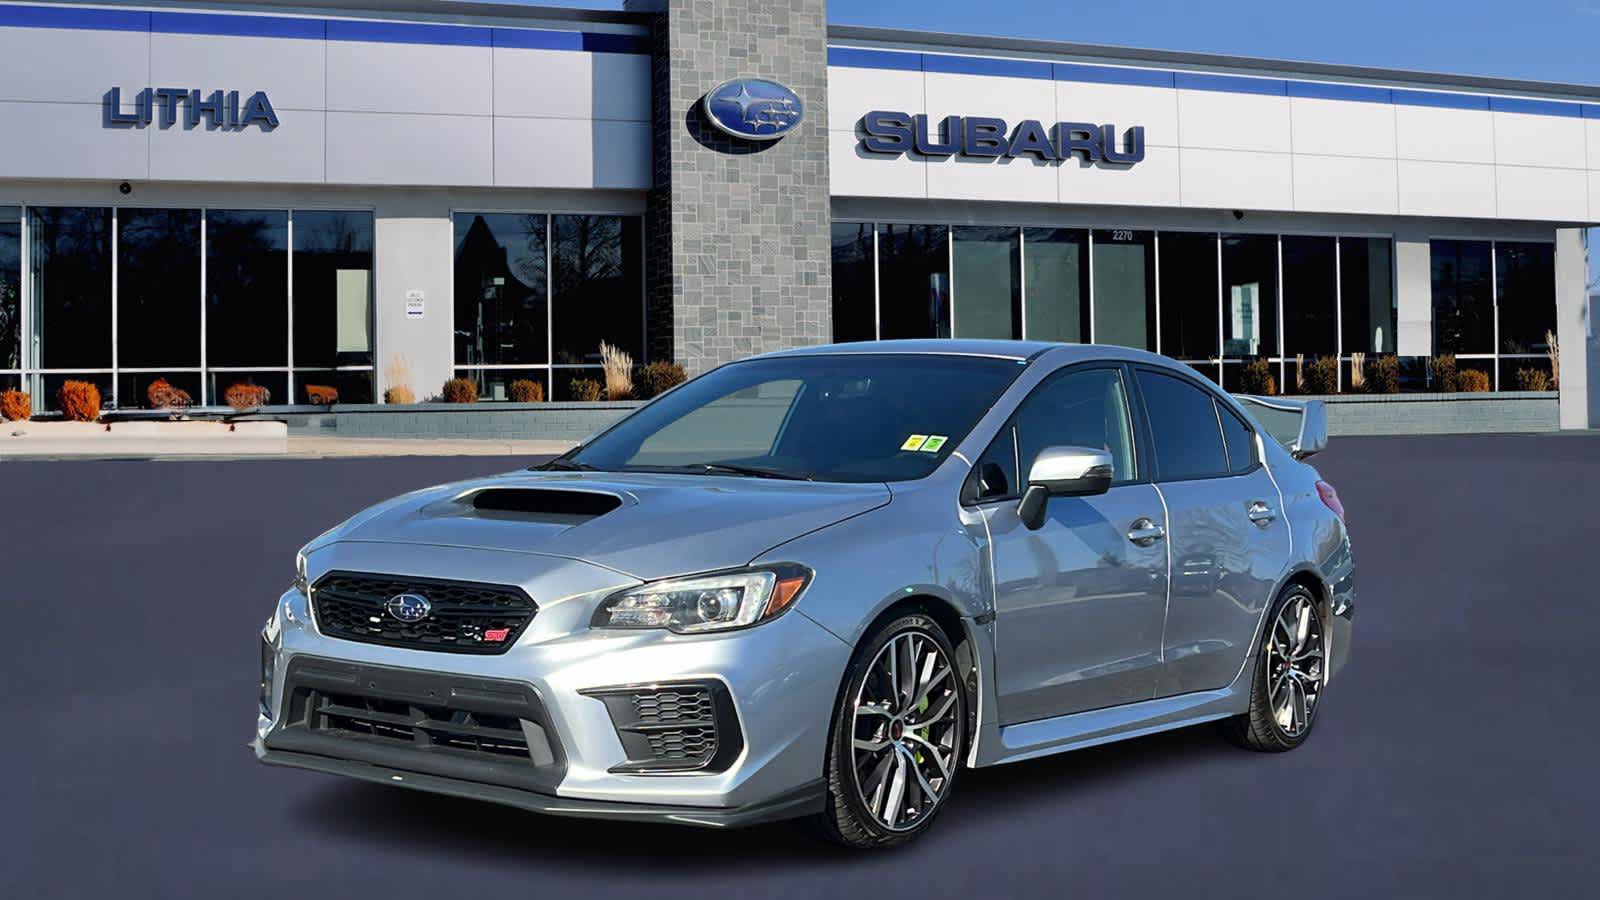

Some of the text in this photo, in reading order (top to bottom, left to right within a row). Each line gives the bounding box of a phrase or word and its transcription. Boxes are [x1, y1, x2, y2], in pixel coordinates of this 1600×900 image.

[110, 87, 280, 128] LITHIA
[863, 110, 1145, 164] SUBARU
[1112, 230, 1133, 241] 2270
